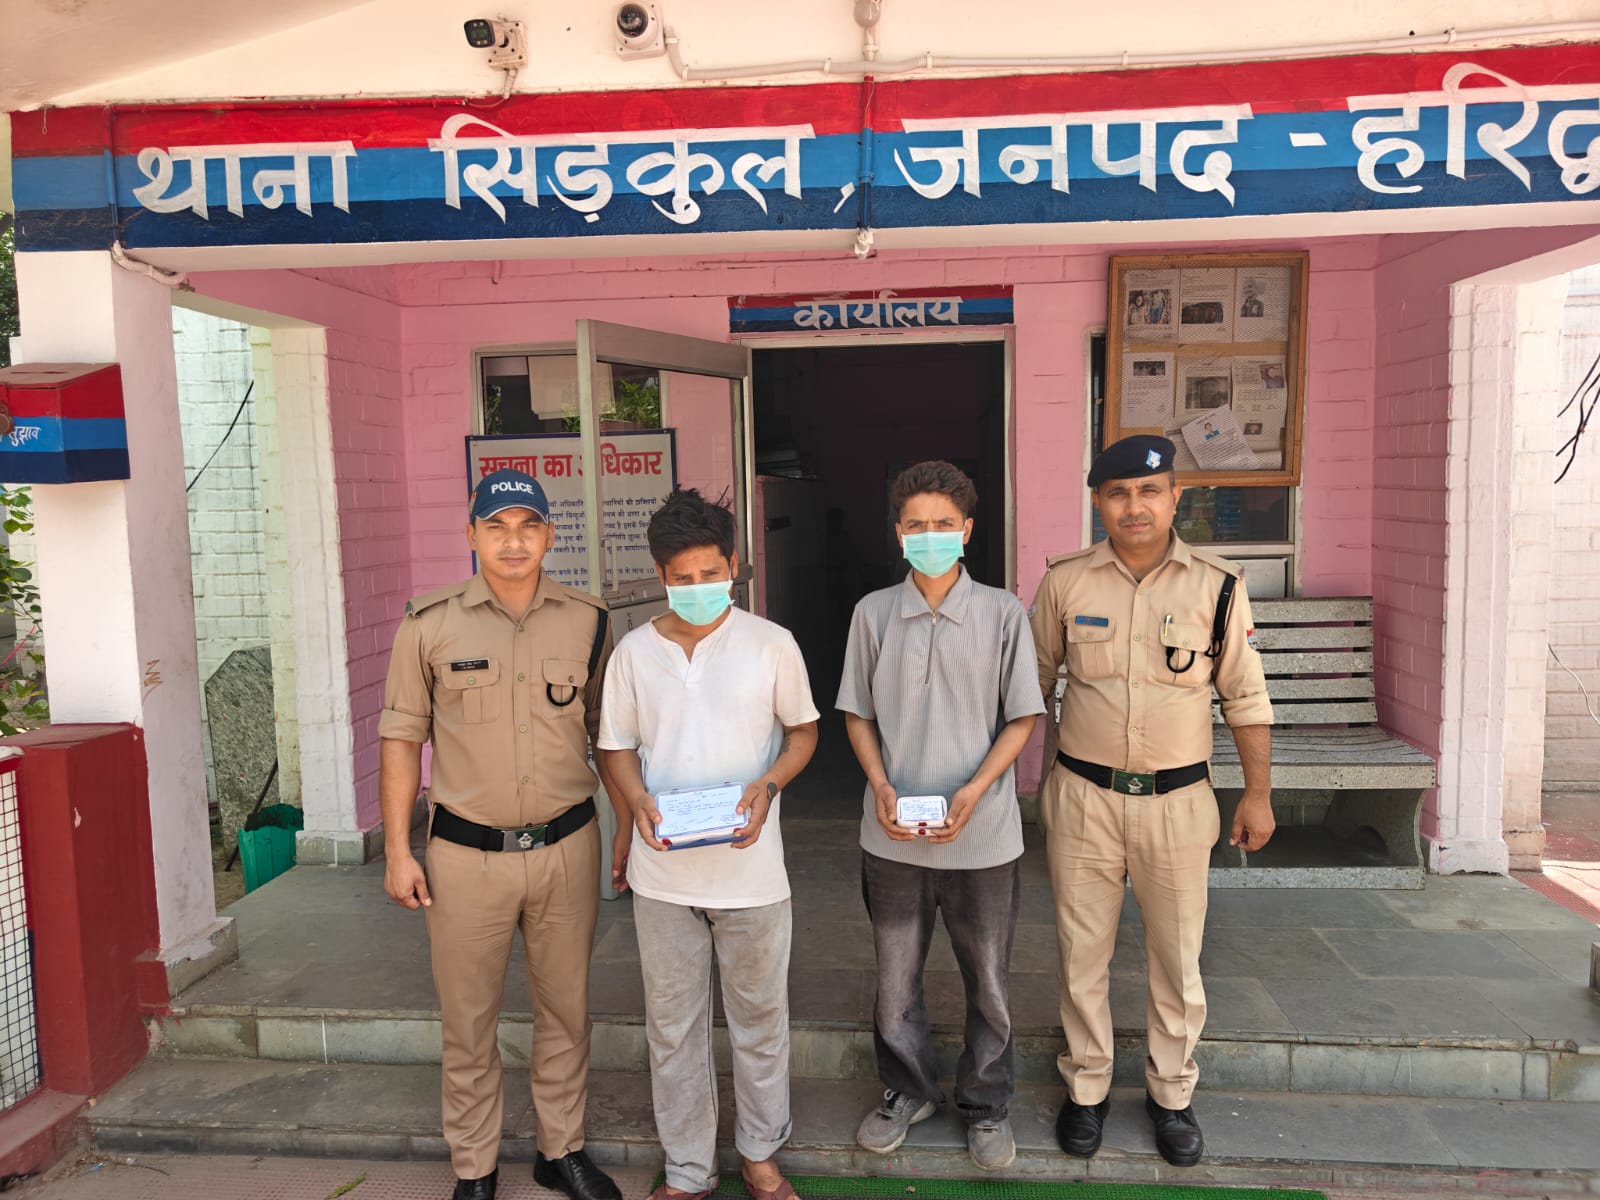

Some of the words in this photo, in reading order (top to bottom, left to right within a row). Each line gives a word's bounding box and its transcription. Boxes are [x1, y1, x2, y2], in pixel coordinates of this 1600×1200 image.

[133, 140, 357, 220] थाना
[894, 102, 1252, 207] जनपद
[793, 289, 964, 330] कार्यालय
[543, 454, 573, 478] का
[577, 443, 663, 479] धिकार
[491, 481, 535, 495] POLICE
